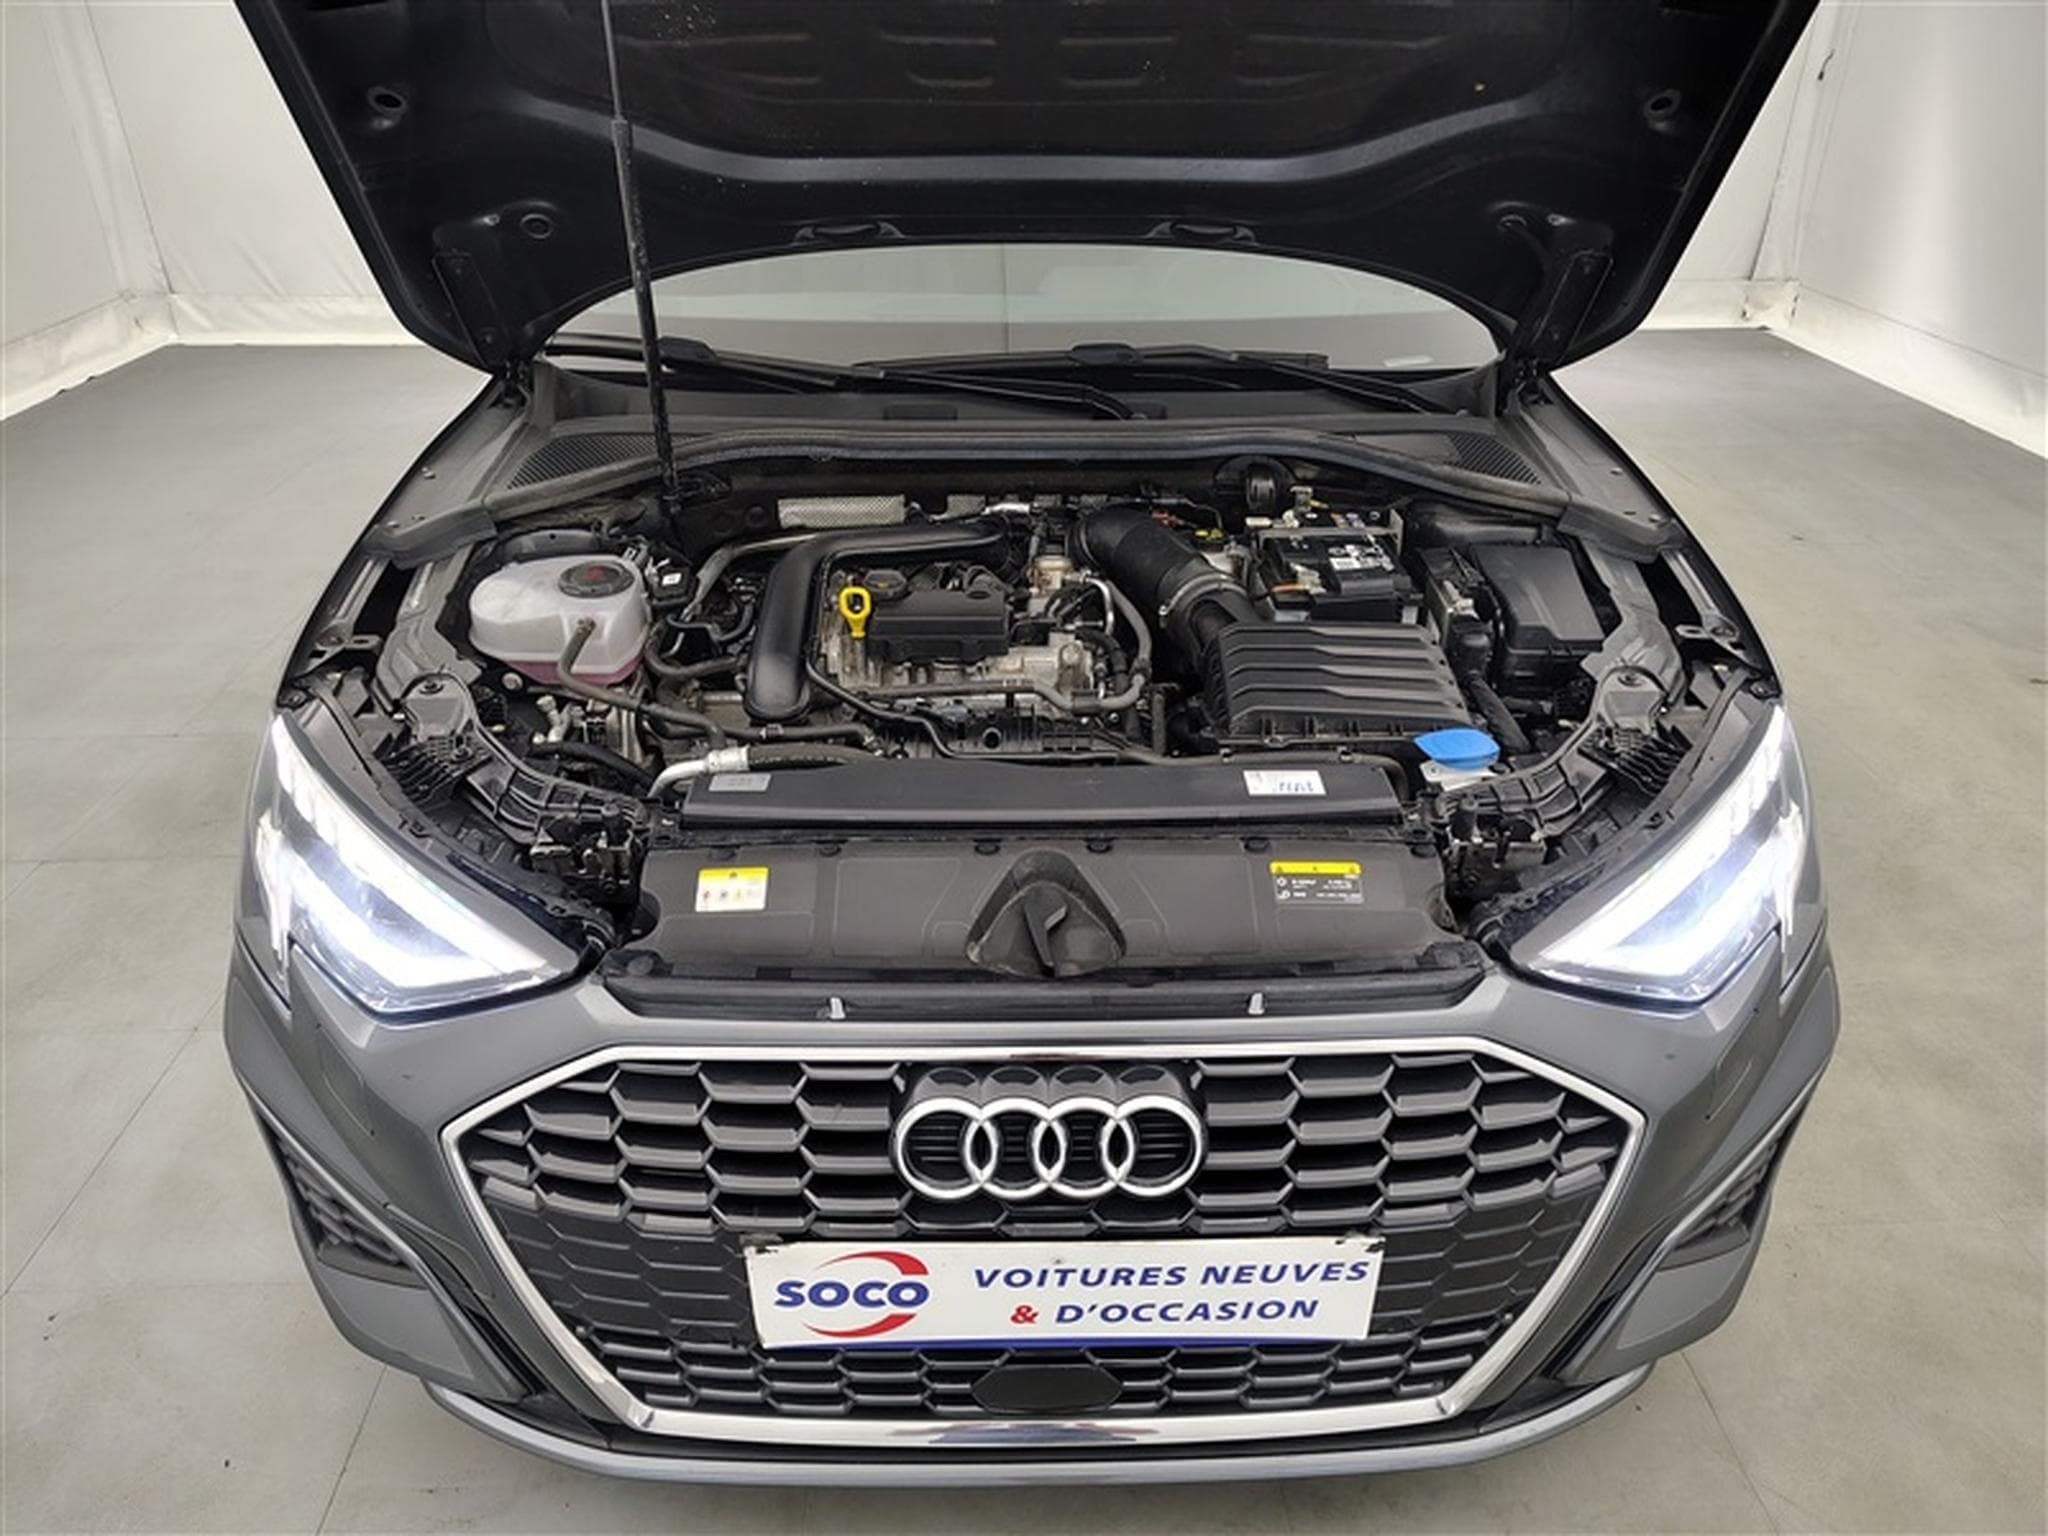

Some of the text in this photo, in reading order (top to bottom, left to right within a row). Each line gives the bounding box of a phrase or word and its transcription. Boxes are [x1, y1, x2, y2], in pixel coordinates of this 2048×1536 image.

[974, 1261, 1369, 1288] VOITURES NEUVES
[774, 1279, 931, 1308] SOCO
[1010, 1299, 1319, 1325] & D'OCCASION
